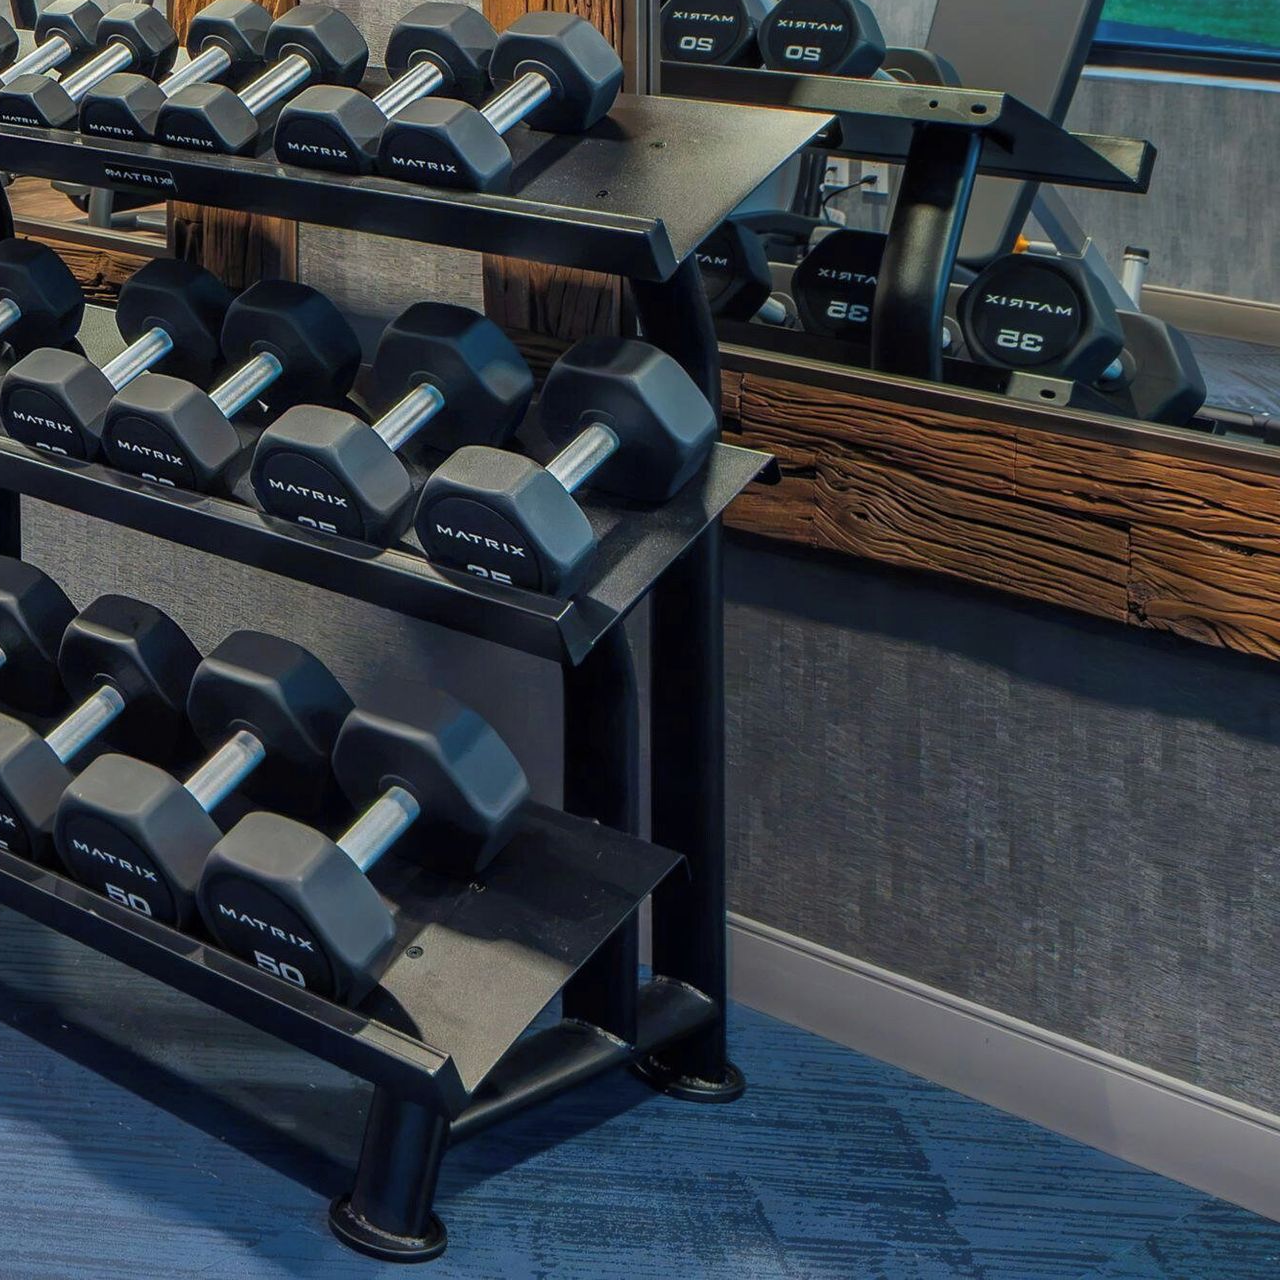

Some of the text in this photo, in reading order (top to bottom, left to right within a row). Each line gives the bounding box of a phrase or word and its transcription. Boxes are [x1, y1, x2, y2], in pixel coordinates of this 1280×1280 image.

[2, 114, 40, 125] MATRIX
[89, 123, 135, 136] MATRIX
[166, 133, 214, 148] MATRIX
[287, 141, 348, 159] MATRIX
[391, 156, 457, 174] MATRIX
[13, 410, 73, 434] MATRIX
[117, 439, 184, 466] MATRIX
[269, 478, 348, 508] MATRIX
[436, 524, 526, 558] MATRIX
[73, 839, 158, 882] MATRIX
[105, 882, 152, 916] 50
[219, 904, 315, 952] MATRIX
[253, 950, 306, 987] 50
